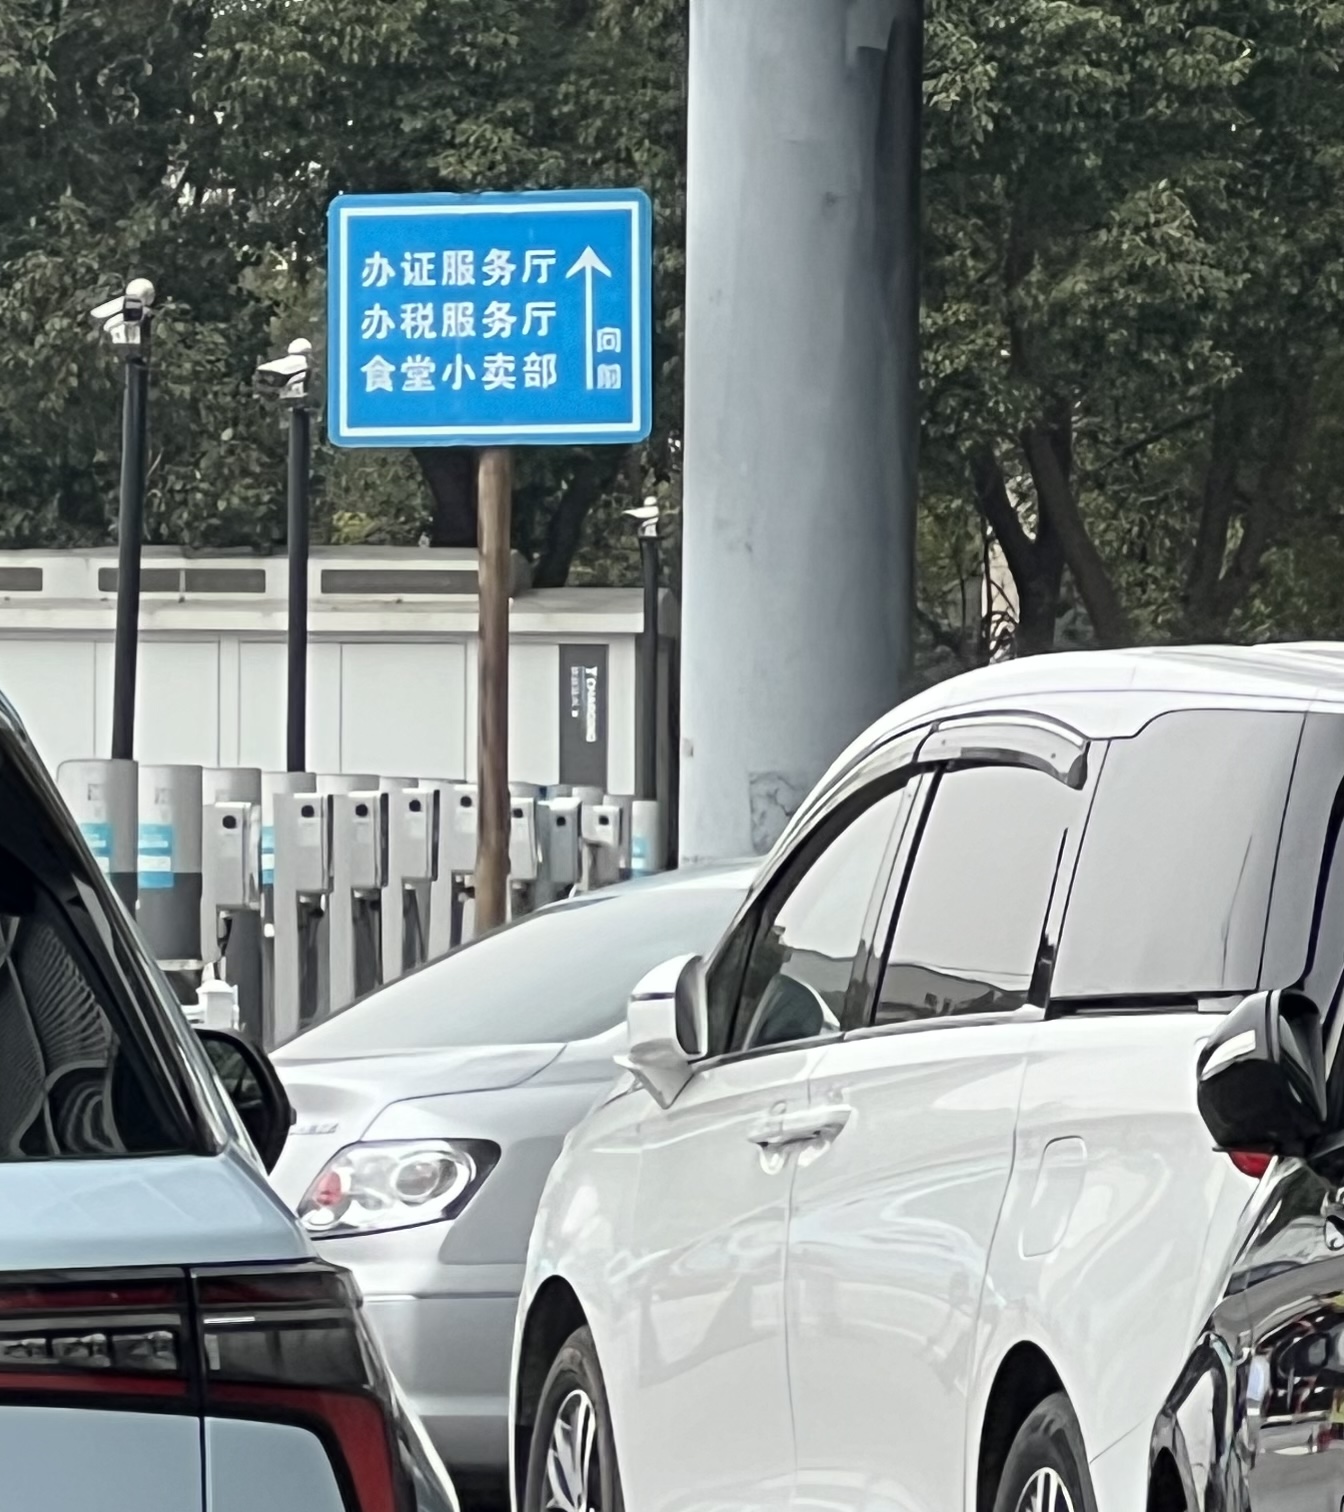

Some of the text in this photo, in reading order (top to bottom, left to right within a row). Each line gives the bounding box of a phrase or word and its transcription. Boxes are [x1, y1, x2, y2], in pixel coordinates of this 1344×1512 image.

[361, 248, 557, 288] 办证服务厅
[361, 301, 557, 339] 办税服务厅
[360, 352, 558, 393] 食堂小卖部
